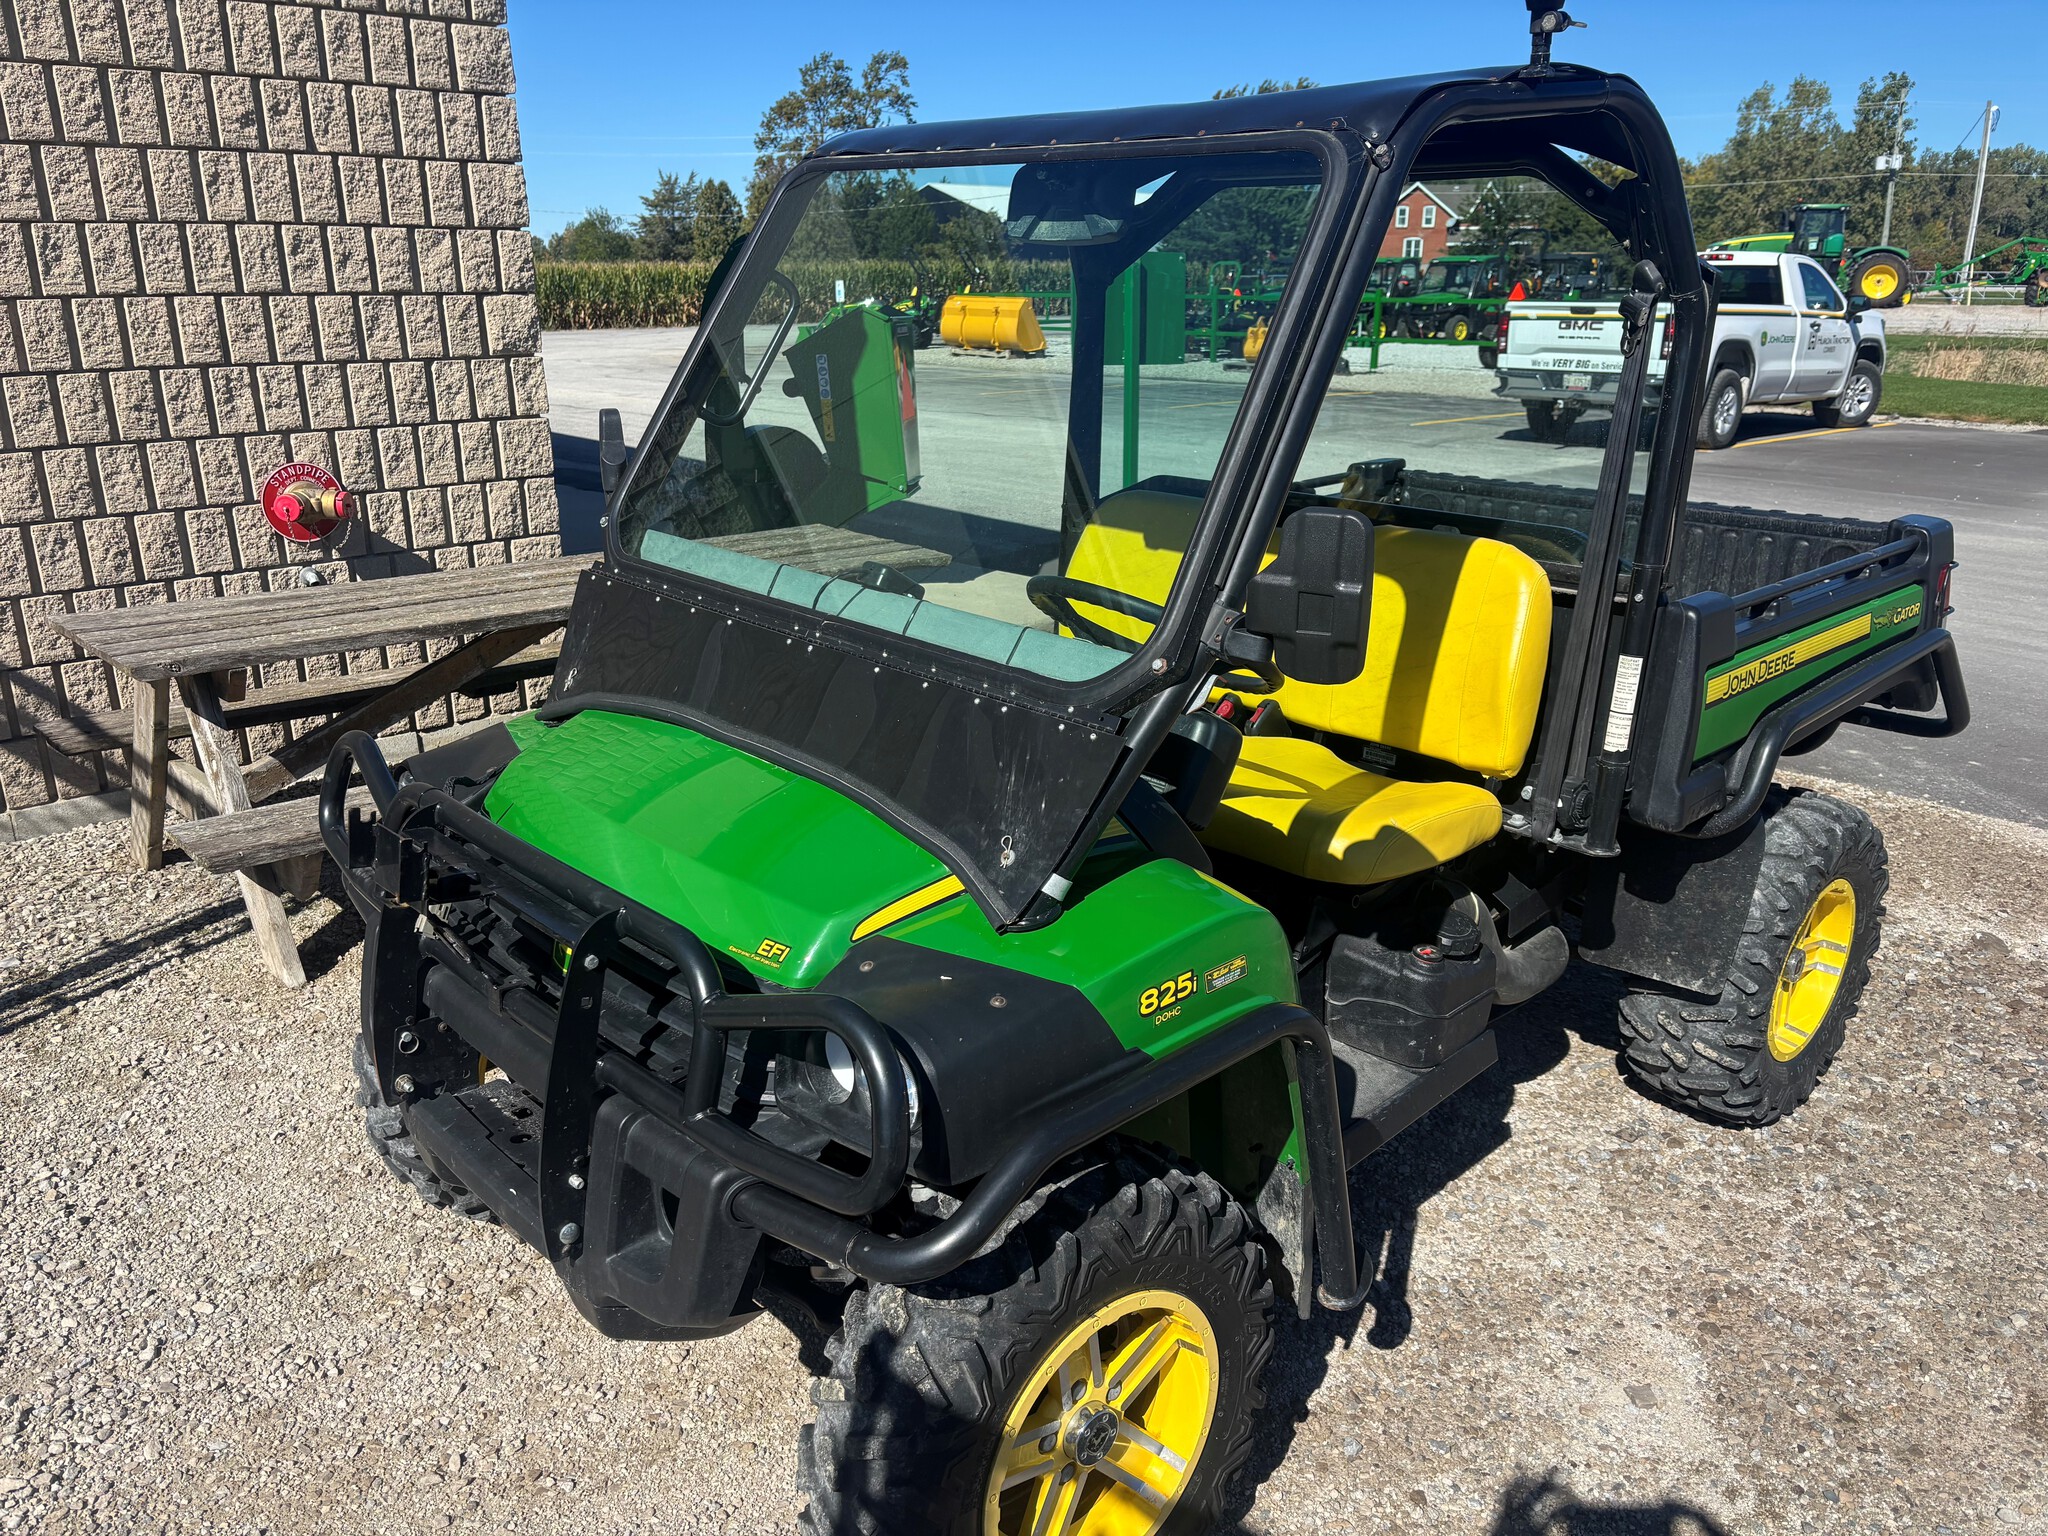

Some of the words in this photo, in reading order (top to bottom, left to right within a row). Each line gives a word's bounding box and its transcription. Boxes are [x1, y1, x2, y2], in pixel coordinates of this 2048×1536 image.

[1558, 320, 1604, 331] GMC
[1767, 335, 1781, 344] JOHN
[1552, 359, 1575, 368] VERY
[1575, 360, 1591, 369] BIG
[1601, 362, 1623, 370] Servic
[270, 465, 330, 487] STANDPIPE
[1893, 602, 1921, 625] GATOR
[1724, 665, 1757, 699] JOHN
[1757, 650, 1797, 682] DEERE
[756, 938, 792, 963] EFI
[1140, 970, 1198, 1016] 825i
[1155, 1006, 1182, 1025] DOHC
